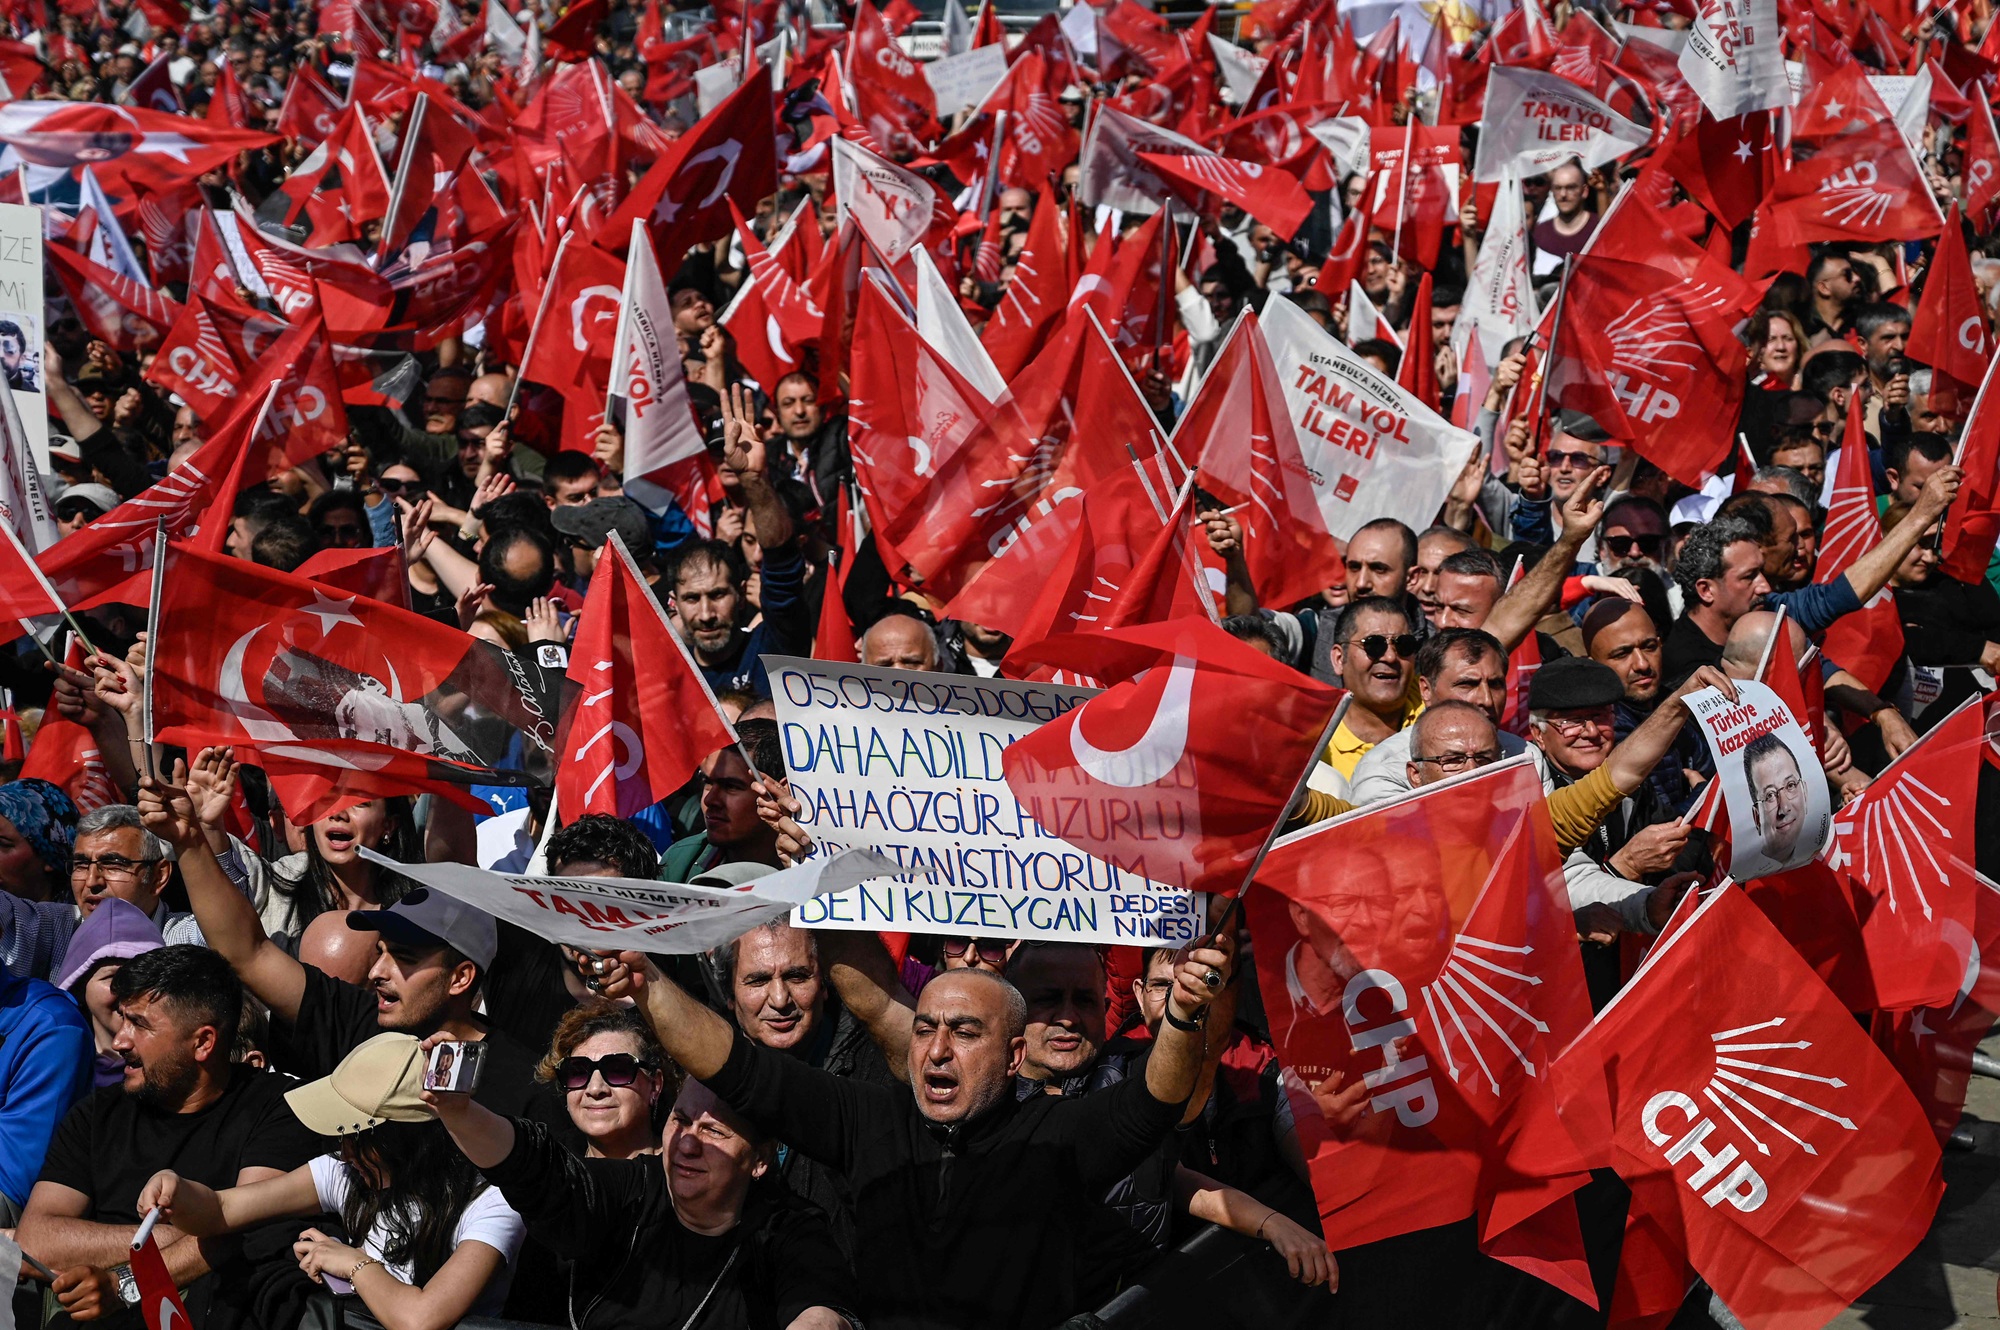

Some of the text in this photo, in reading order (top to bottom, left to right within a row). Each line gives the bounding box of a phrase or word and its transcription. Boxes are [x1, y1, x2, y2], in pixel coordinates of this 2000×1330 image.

[876, 47, 914, 77] CHP
[1522, 101, 1570, 118] TAM
[1577, 107, 1613, 134] YOL
[268, 282, 314, 314] HP
[168, 346, 238, 397] CHP
[1309, 352, 1409, 416] İSTANBUL'A HİZMET
[1294, 364, 1411, 445] TAM YOL
[1604, 370, 1681, 424] HP
[1300, 400, 1381, 460] İLERİ
[782, 671, 1089, 722] 05.05.2025 DOĞA
[1697, 697, 1712, 714] CHP
[1706, 702, 1758, 735] Türkiye
[783, 722, 899, 777] DAHA
[900, 725, 983, 779] ADİL
[1715, 706, 1790, 757] kazanacak!
[790, 783, 888, 830] DAHA
[846, 843, 955, 886] TAN
[512, 886, 630, 924] TAM
[616, 886, 721, 908] HİZMETTE
[799, 884, 893, 923] BEN
[1110, 890, 1196, 915] DEDESİ
[1114, 912, 1201, 940] NİNESİ
[1341, 968, 1439, 1128] CHP
[1641, 1090, 1769, 1213] CHP
